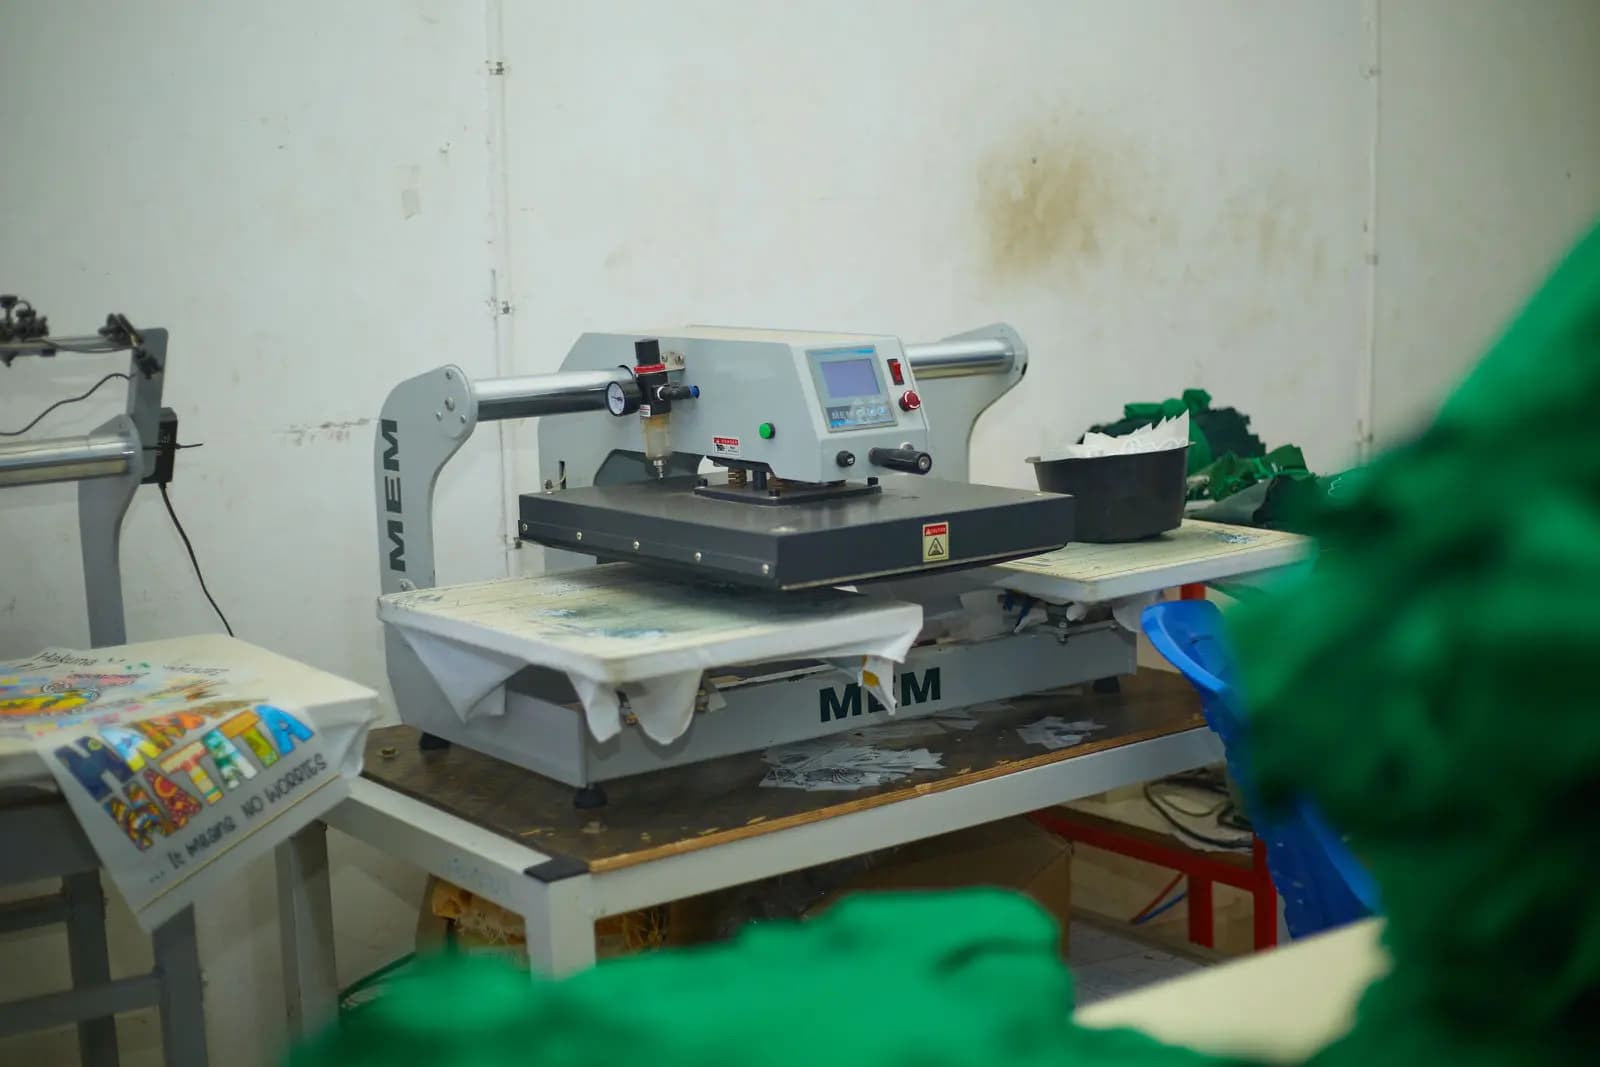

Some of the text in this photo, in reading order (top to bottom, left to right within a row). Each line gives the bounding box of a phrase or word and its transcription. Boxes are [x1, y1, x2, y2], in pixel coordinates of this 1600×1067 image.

[381, 418, 406, 572] MEM
[103, 704, 314, 852] MATATA
[240, 795, 265, 819] NO
